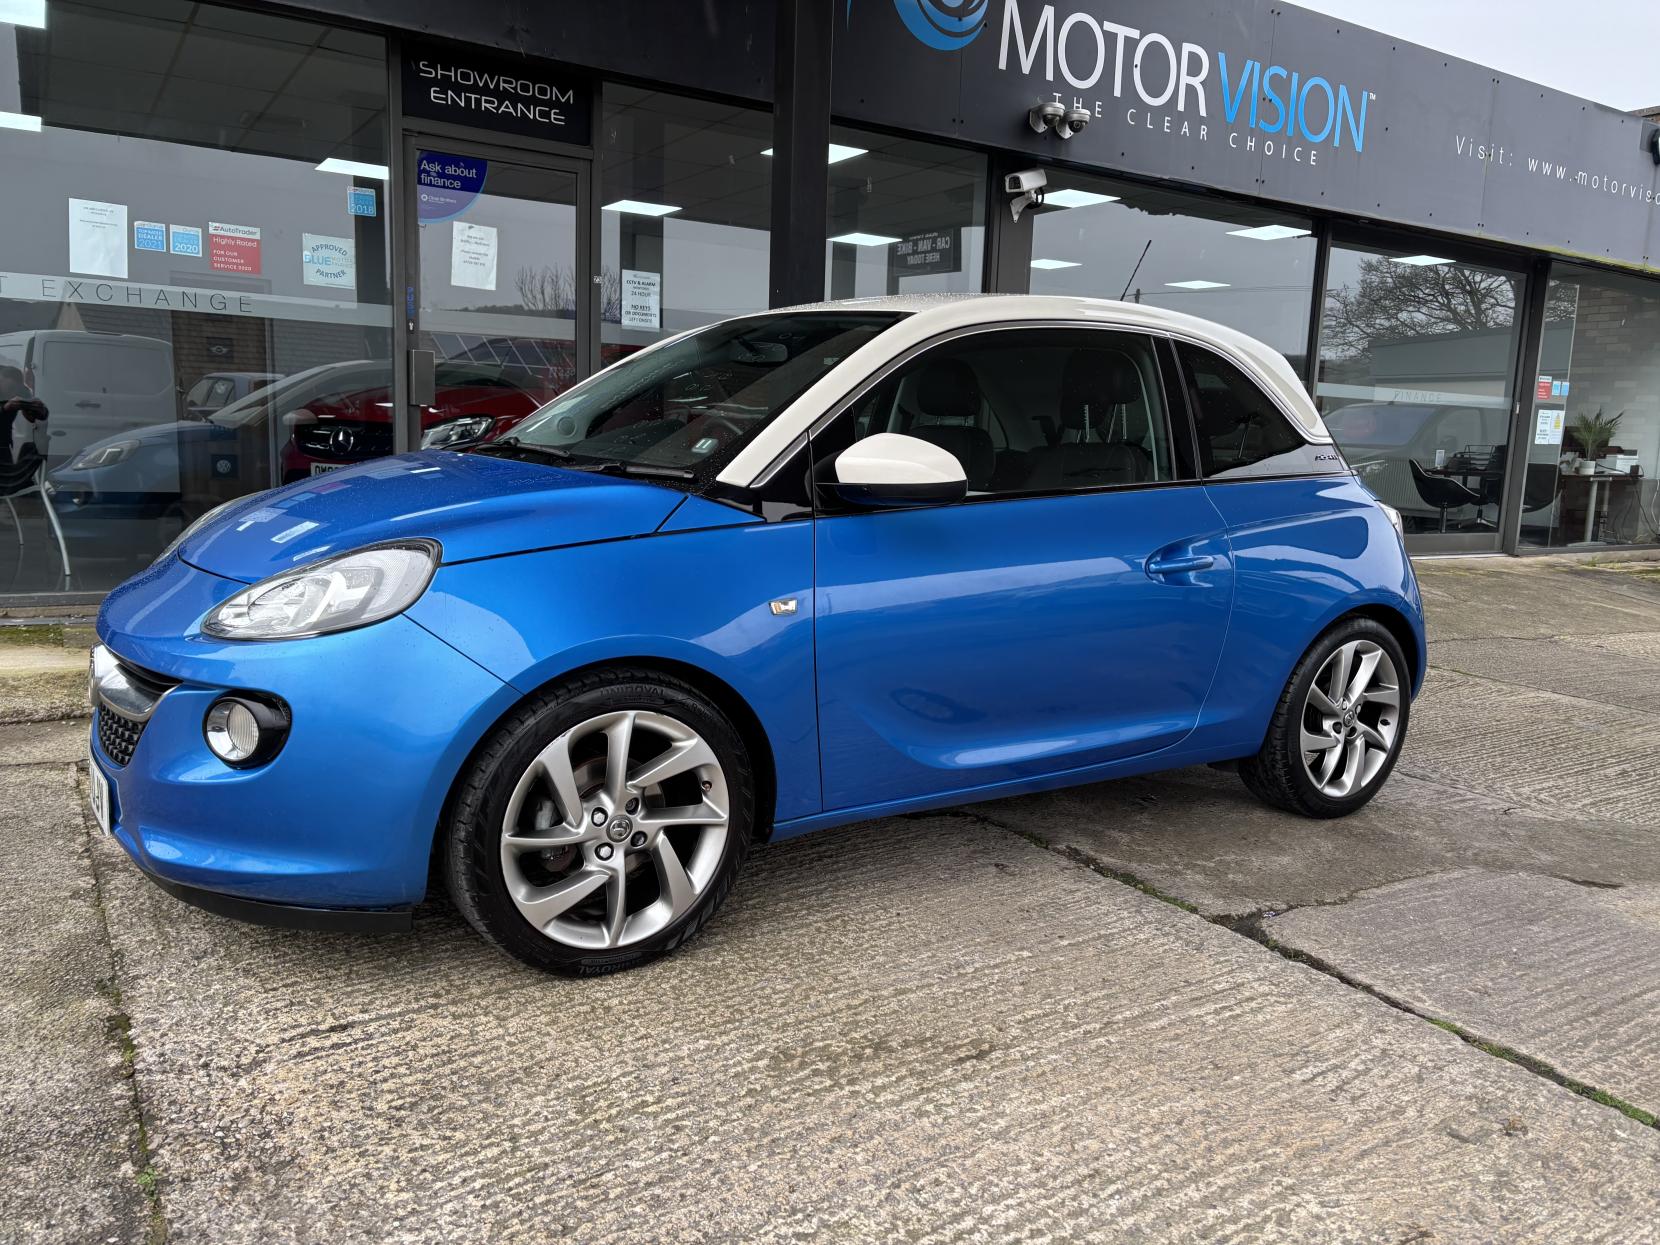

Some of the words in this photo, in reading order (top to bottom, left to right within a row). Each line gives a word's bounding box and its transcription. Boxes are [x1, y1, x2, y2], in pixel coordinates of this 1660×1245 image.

[419, 61, 574, 104] SHOWROOM
[998, 0, 1210, 117] MOTOR
[1218, 51, 1368, 153] VISION
[430, 87, 566, 125] ENTRANCE
[1052, 92, 1102, 118] THE
[1127, 109, 1208, 142] CLEAR
[1229, 132, 1317, 166] CHOICE
[1456, 135, 1513, 166] Visit:
[421, 160, 442, 173] Ask
[445, 164, 477, 178] about
[421, 173, 461, 188] finance
[351, 204, 374, 214] 2018
[139, 239, 163, 250] 2021
[175, 242, 198, 253] 2020
[213, 237, 235, 246] Highly
[236, 239, 257, 248] Rated
[311, 243, 348, 257] APPROVED
[304, 253, 332, 266] BLUE
[315, 268, 347, 279] PARTNER
[41, 279, 253, 313] EXCHANGE
